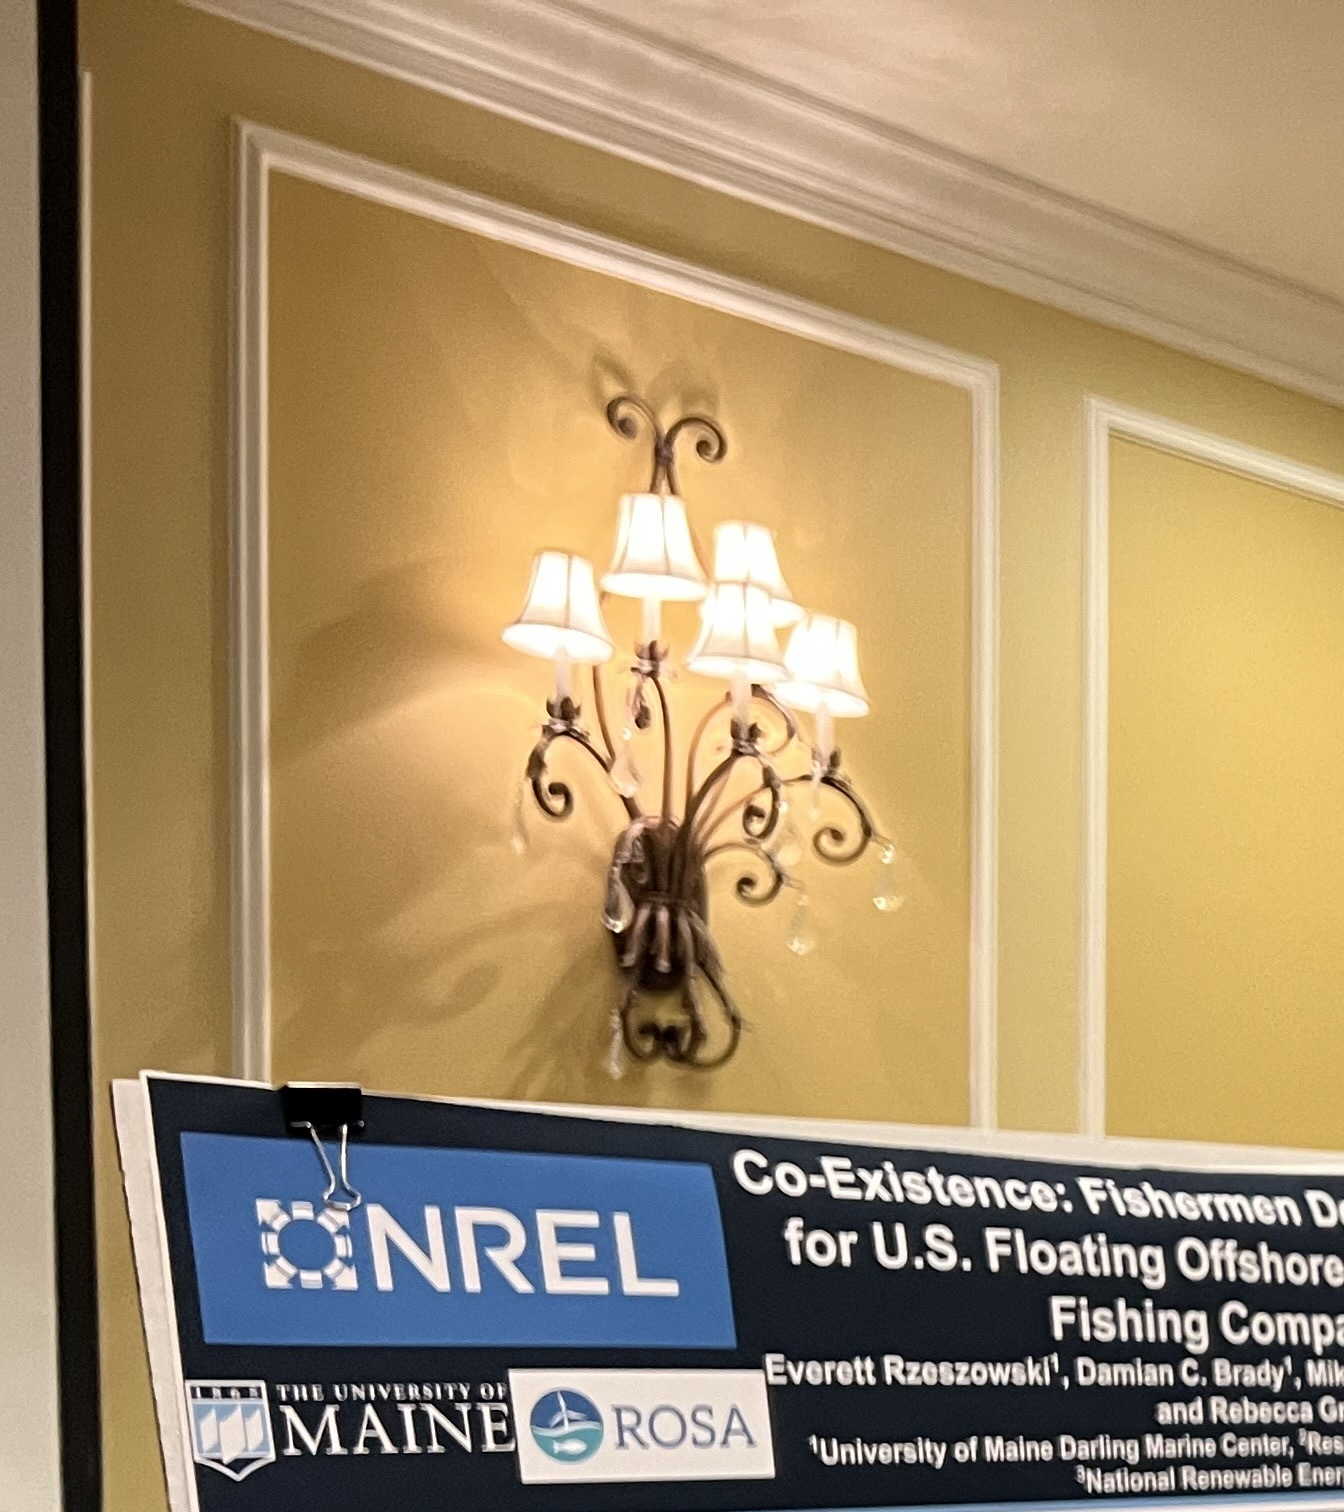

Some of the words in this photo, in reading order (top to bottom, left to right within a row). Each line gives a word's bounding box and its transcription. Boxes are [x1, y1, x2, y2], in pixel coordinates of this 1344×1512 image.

[733, 1150, 1073, 1212] Co-Existence:
[1076, 1177, 1302, 1226] Fishermen
[367, 1205, 679, 1296] NREL
[784, 1220, 858, 1267] for
[873, 1223, 971, 1271] U.S.
[985, 1227, 1166, 1289] Floating
[1177, 1237, 1344, 1287] Offshore
[1051, 1296, 1209, 1354] Fishing
[276, 1385, 324, 1401] THE
[334, 1383, 470, 1401] UNIVERSITY
[480, 1383, 508, 1400] OF
[766, 1355, 876, 1384] Everett
[1077, 1357, 1174, 1386] Damian
[1180, 1358, 1207, 1386] C.
[279, 1403, 516, 1455] MAINE
[612, 1404, 756, 1449] ROSA
[1157, 1396, 1203, 1424] and
[1210, 1396, 1313, 1424] Rebecca
[954, 1436, 977, 1462] of
[984, 1436, 1053, 1461] Maine
[1060, 1434, 1139, 1464] Darling
[1145, 1433, 1216, 1458] Marine
[1221, 1432, 1294, 1459] Center,
[1181, 1464, 1292, 1490] Renewable
